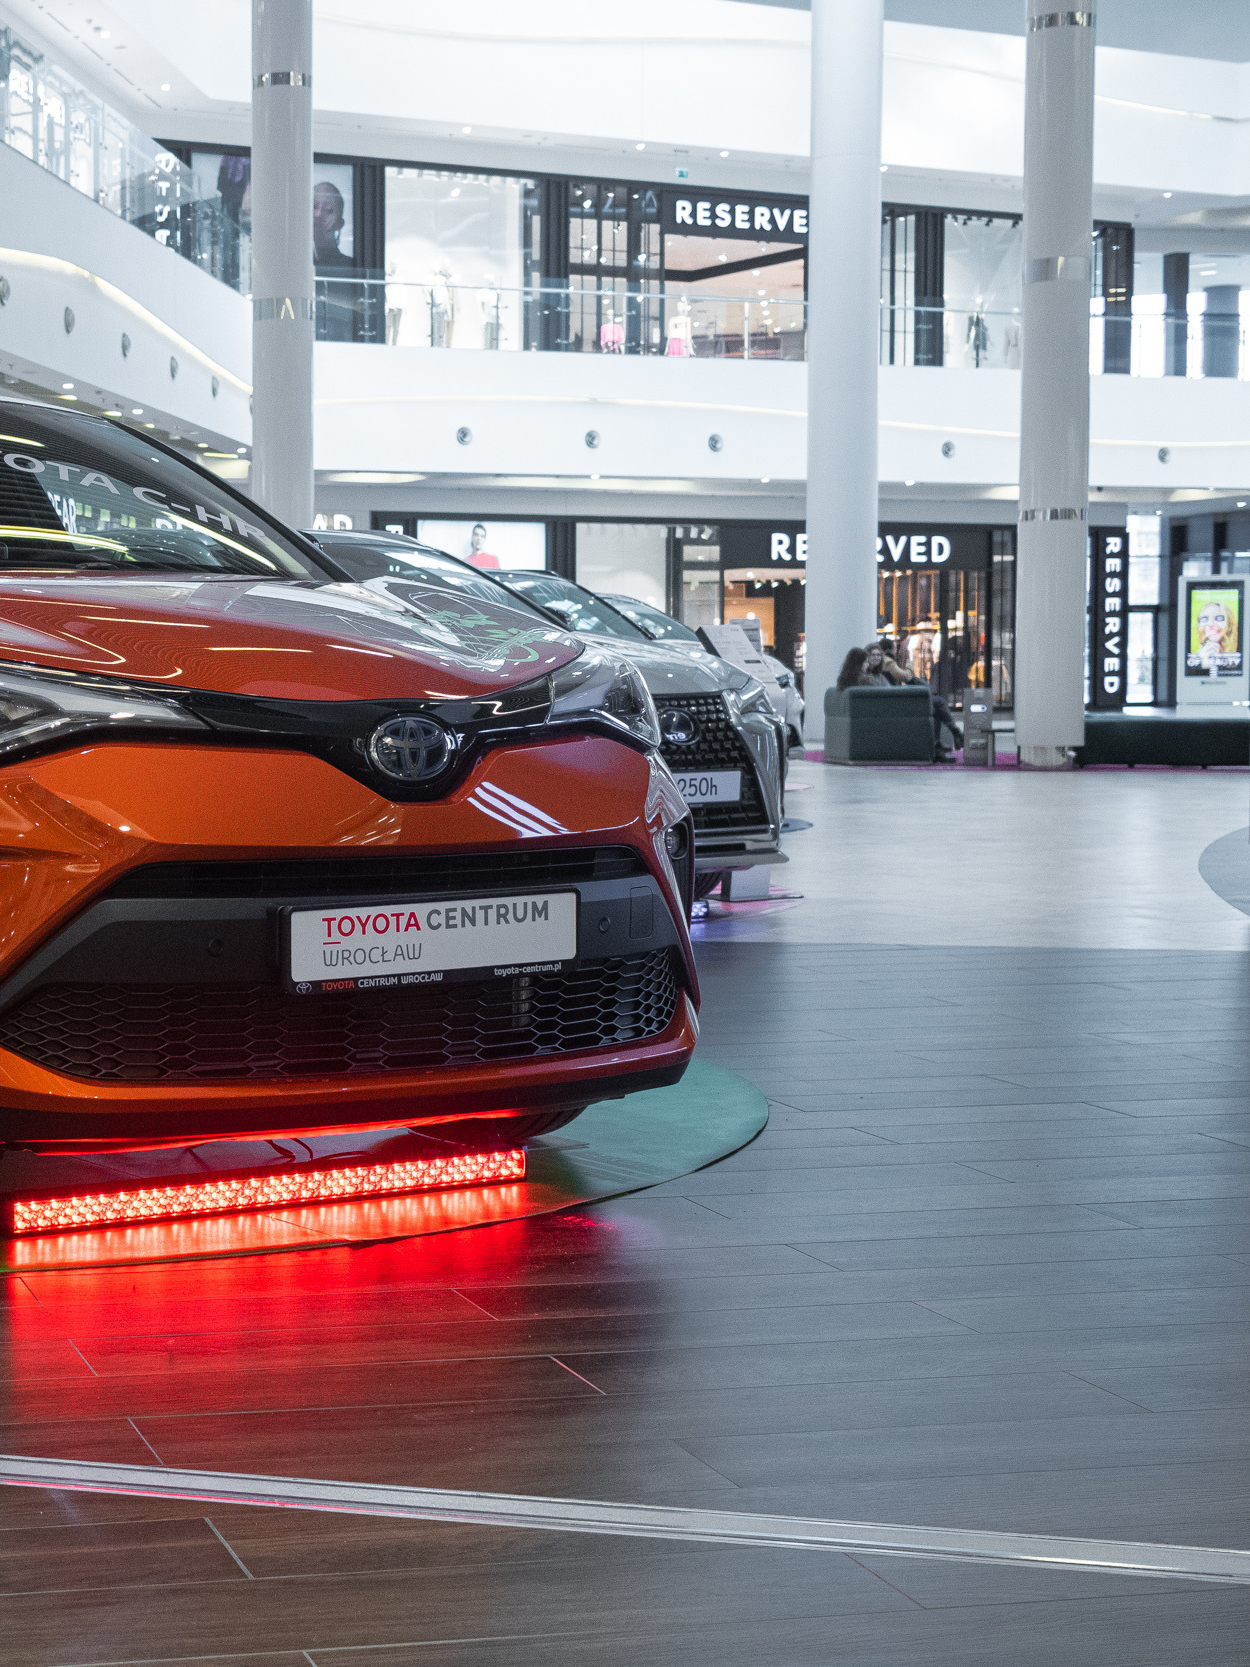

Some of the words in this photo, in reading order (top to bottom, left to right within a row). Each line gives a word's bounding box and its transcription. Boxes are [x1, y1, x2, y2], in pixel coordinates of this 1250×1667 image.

[132, 486, 271, 545] C-HR
[1103, 536, 1123, 694] RESERVED
[321, 911, 422, 939] TOYOTA
[426, 900, 550, 931] CENTRUM
[322, 942, 423, 967] WROCŁAW
[493, 961, 562, 977] toyota-centrum.pl
[321, 980, 356, 991] TOYOTA
[357, 976, 399, 989] CENTRUM
[400, 971, 444, 985] WROCŁAW
